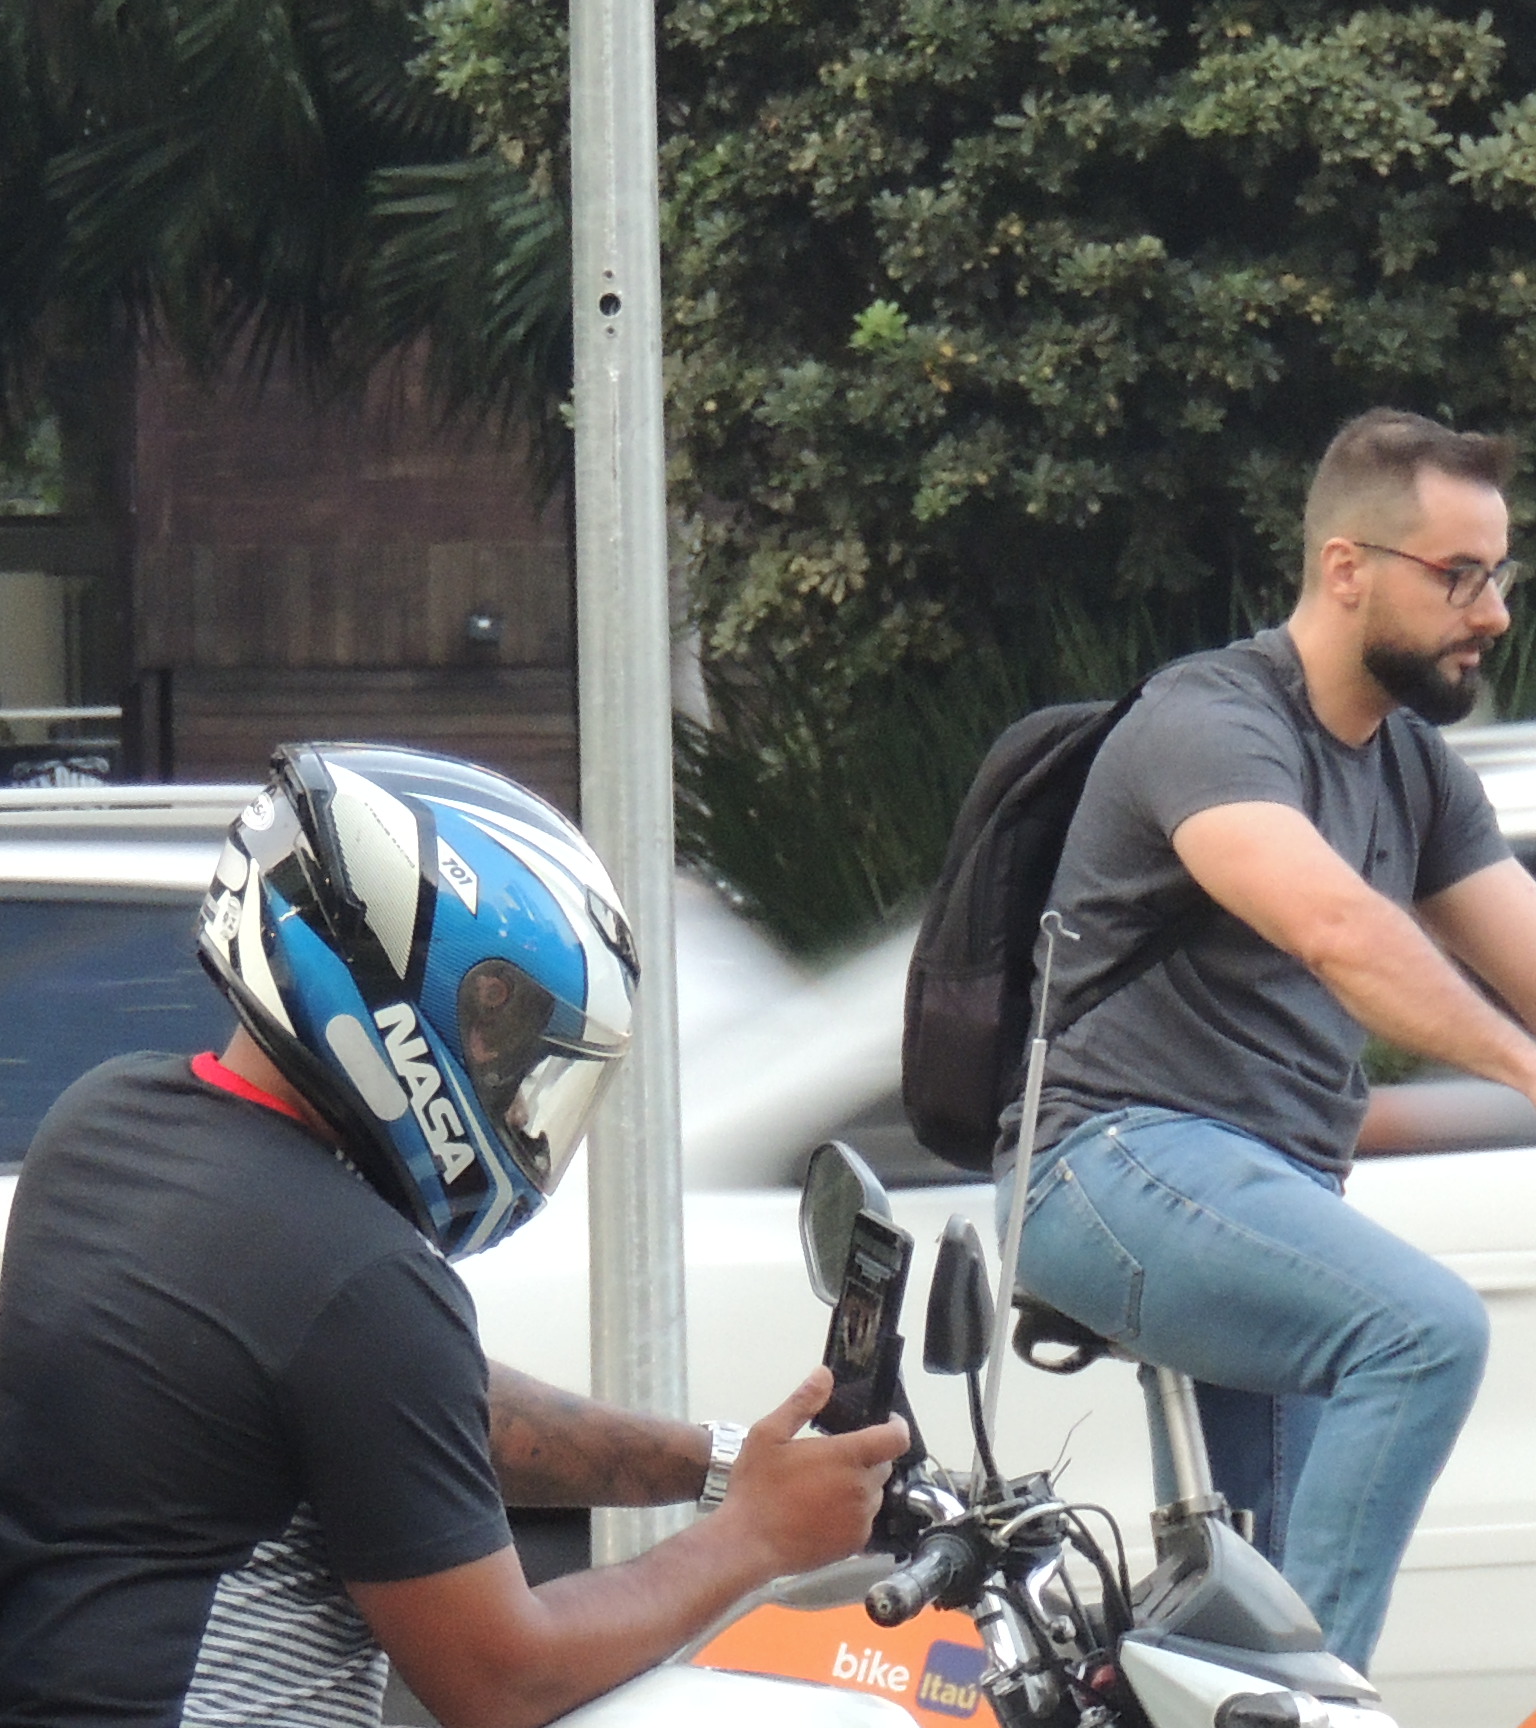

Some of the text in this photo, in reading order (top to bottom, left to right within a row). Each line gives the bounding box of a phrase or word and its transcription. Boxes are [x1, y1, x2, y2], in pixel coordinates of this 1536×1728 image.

[441, 857, 474, 886] 701
[372, 1001, 477, 1187] NASA
[831, 1641, 978, 1712] bike Itaú
